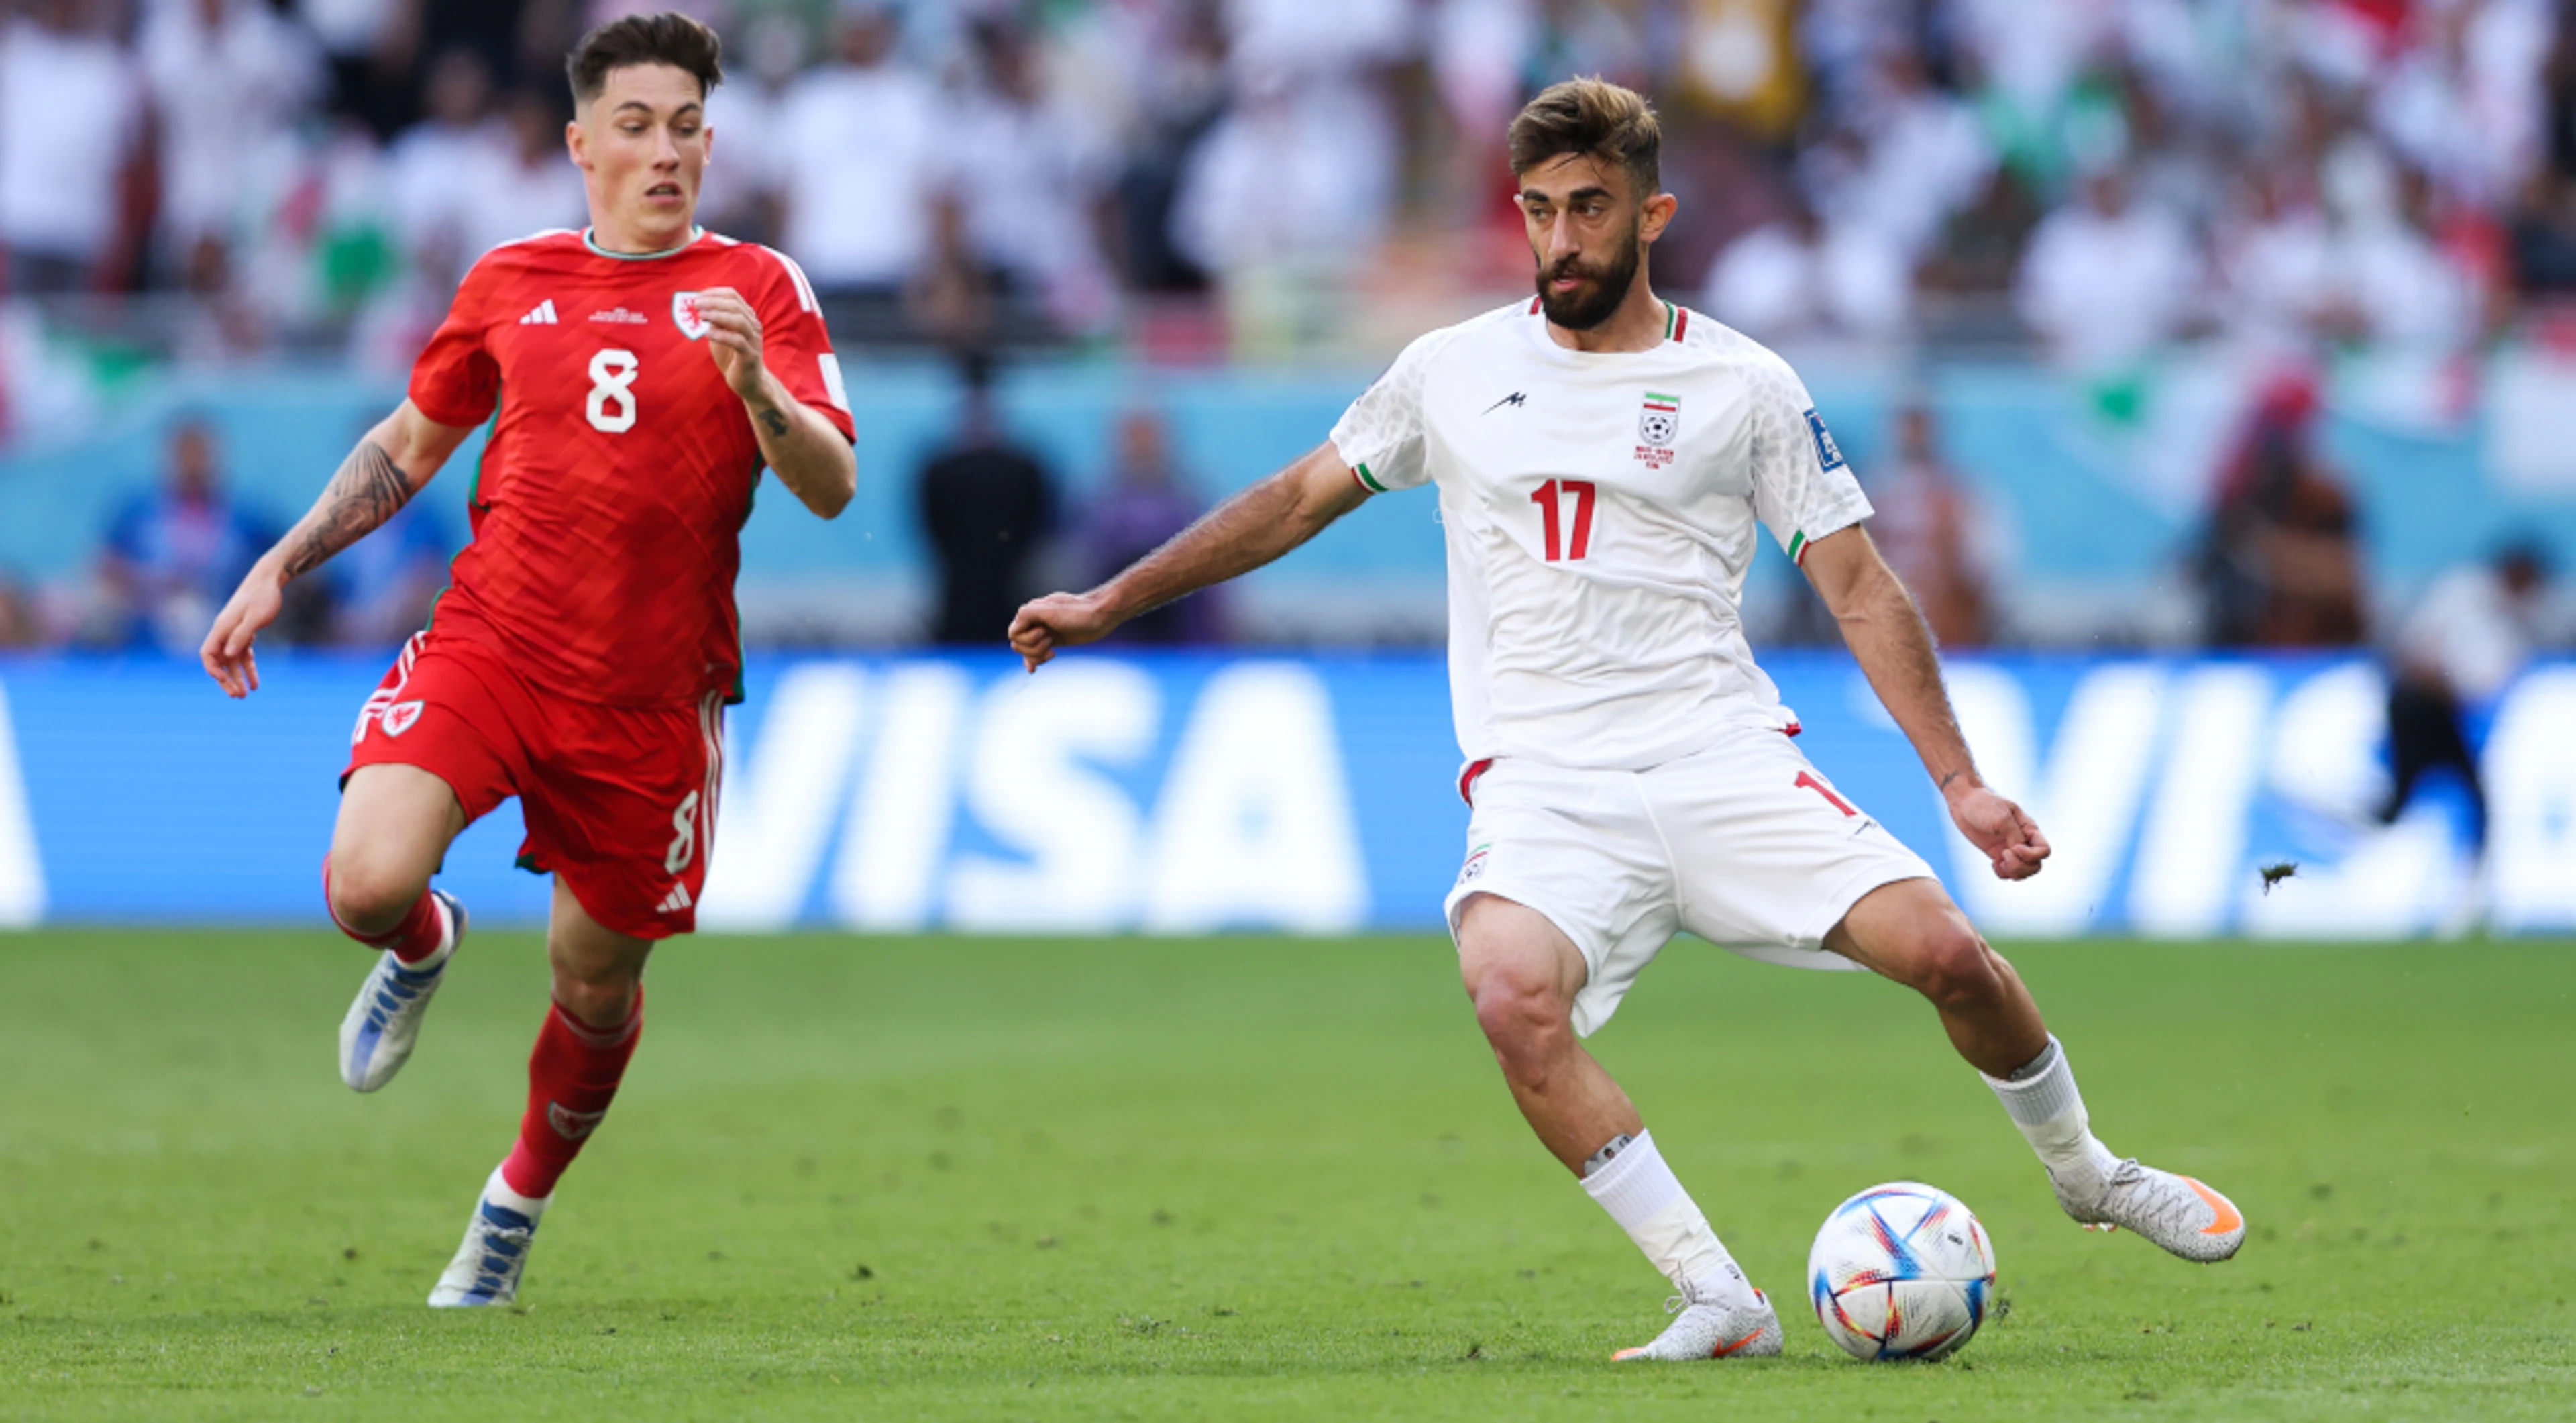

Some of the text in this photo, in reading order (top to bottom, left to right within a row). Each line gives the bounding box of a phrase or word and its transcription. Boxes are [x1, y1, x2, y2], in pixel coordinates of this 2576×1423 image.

[586, 348, 639, 433] 8
[1531, 478, 1595, 561] 17
[665, 790, 699, 874] 8
[695, 657, 1374, 931] VISA
